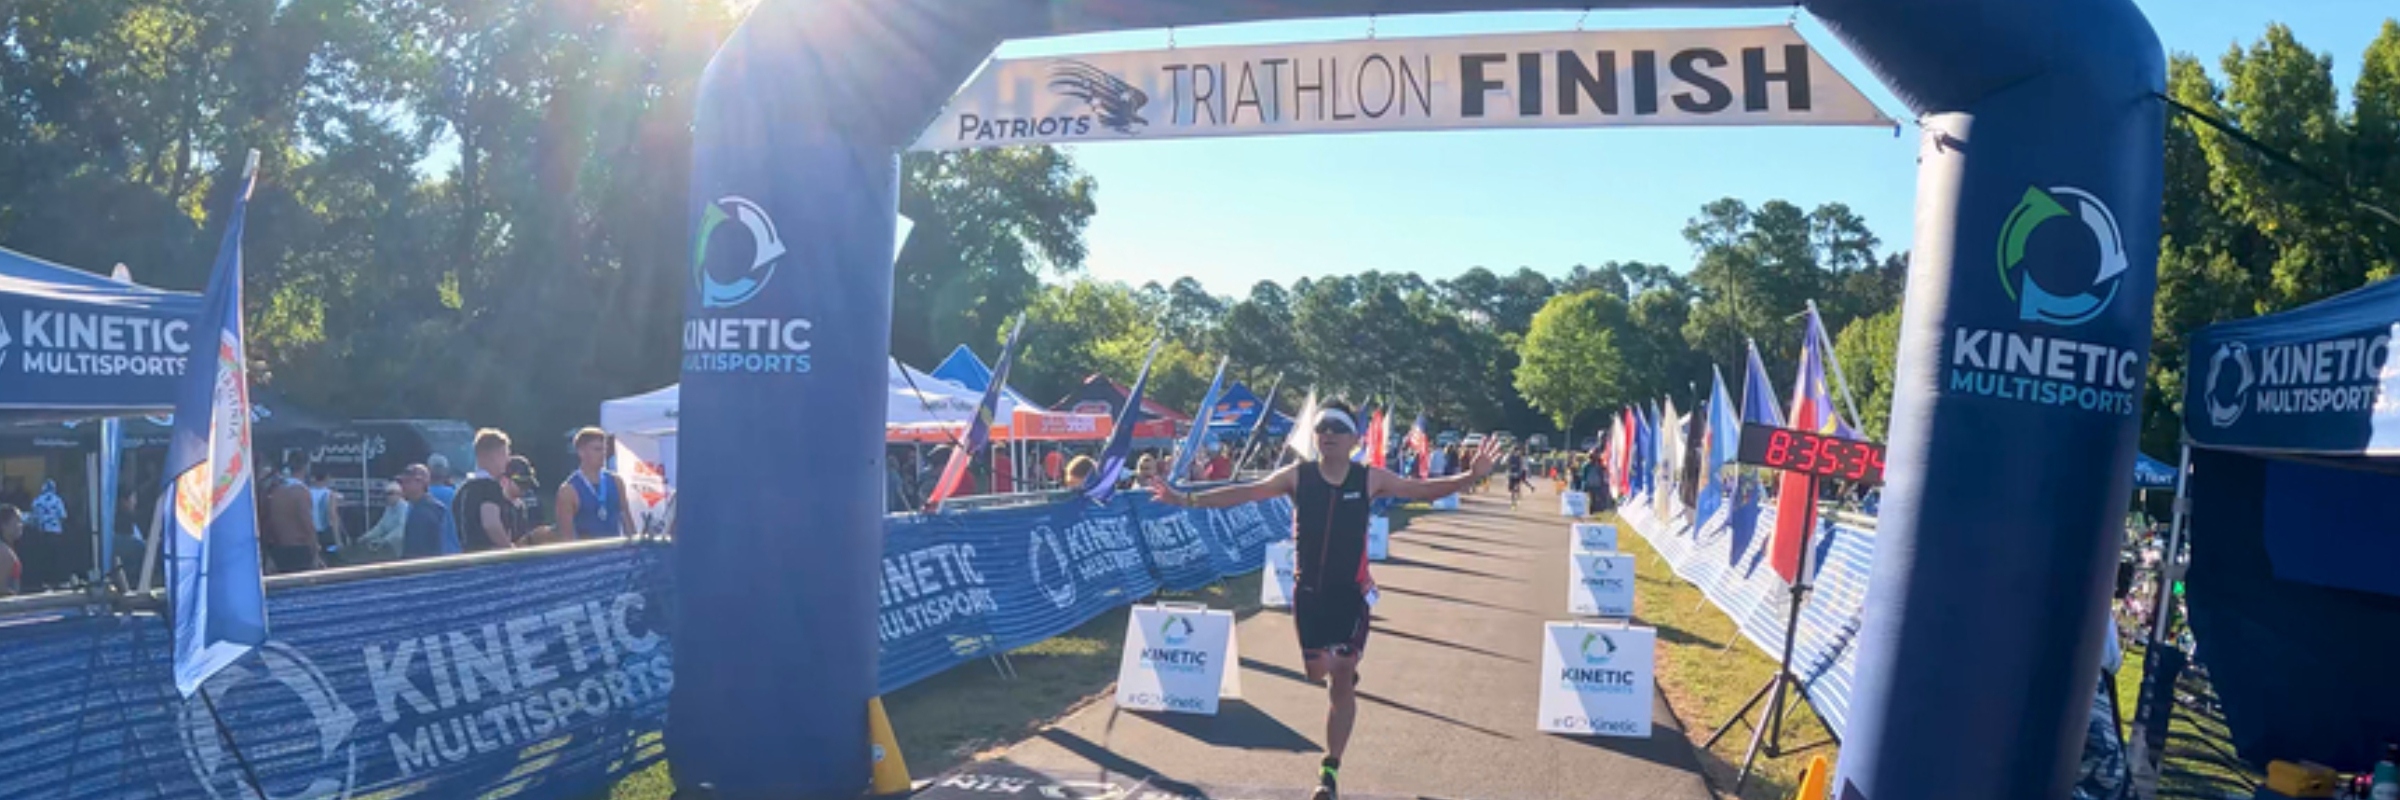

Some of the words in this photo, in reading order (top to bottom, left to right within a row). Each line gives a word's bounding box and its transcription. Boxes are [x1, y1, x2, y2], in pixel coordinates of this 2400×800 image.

[1162, 54, 1432, 125] TRIATHLON
[1460, 44, 1811, 117] FINISH
[958, 114, 1090, 140] PATRIOTS
[22, 309, 190, 353] KINETIC
[23, 352, 188, 376] MULTISPORTS
[1953, 327, 2138, 389] KINETIC
[2259, 334, 2393, 387] KINETIC
[1951, 369, 2133, 415] MULTISPORTS
[1766, 429, 1885, 482] 8:35:34
[879, 543, 985, 606] INETIC
[363, 591, 660, 723] KINETIC
[1140, 648, 1208, 665] KINETIC
[1561, 667, 1635, 686] KINETIC
[388, 653, 675, 777] MULTISPORTS
